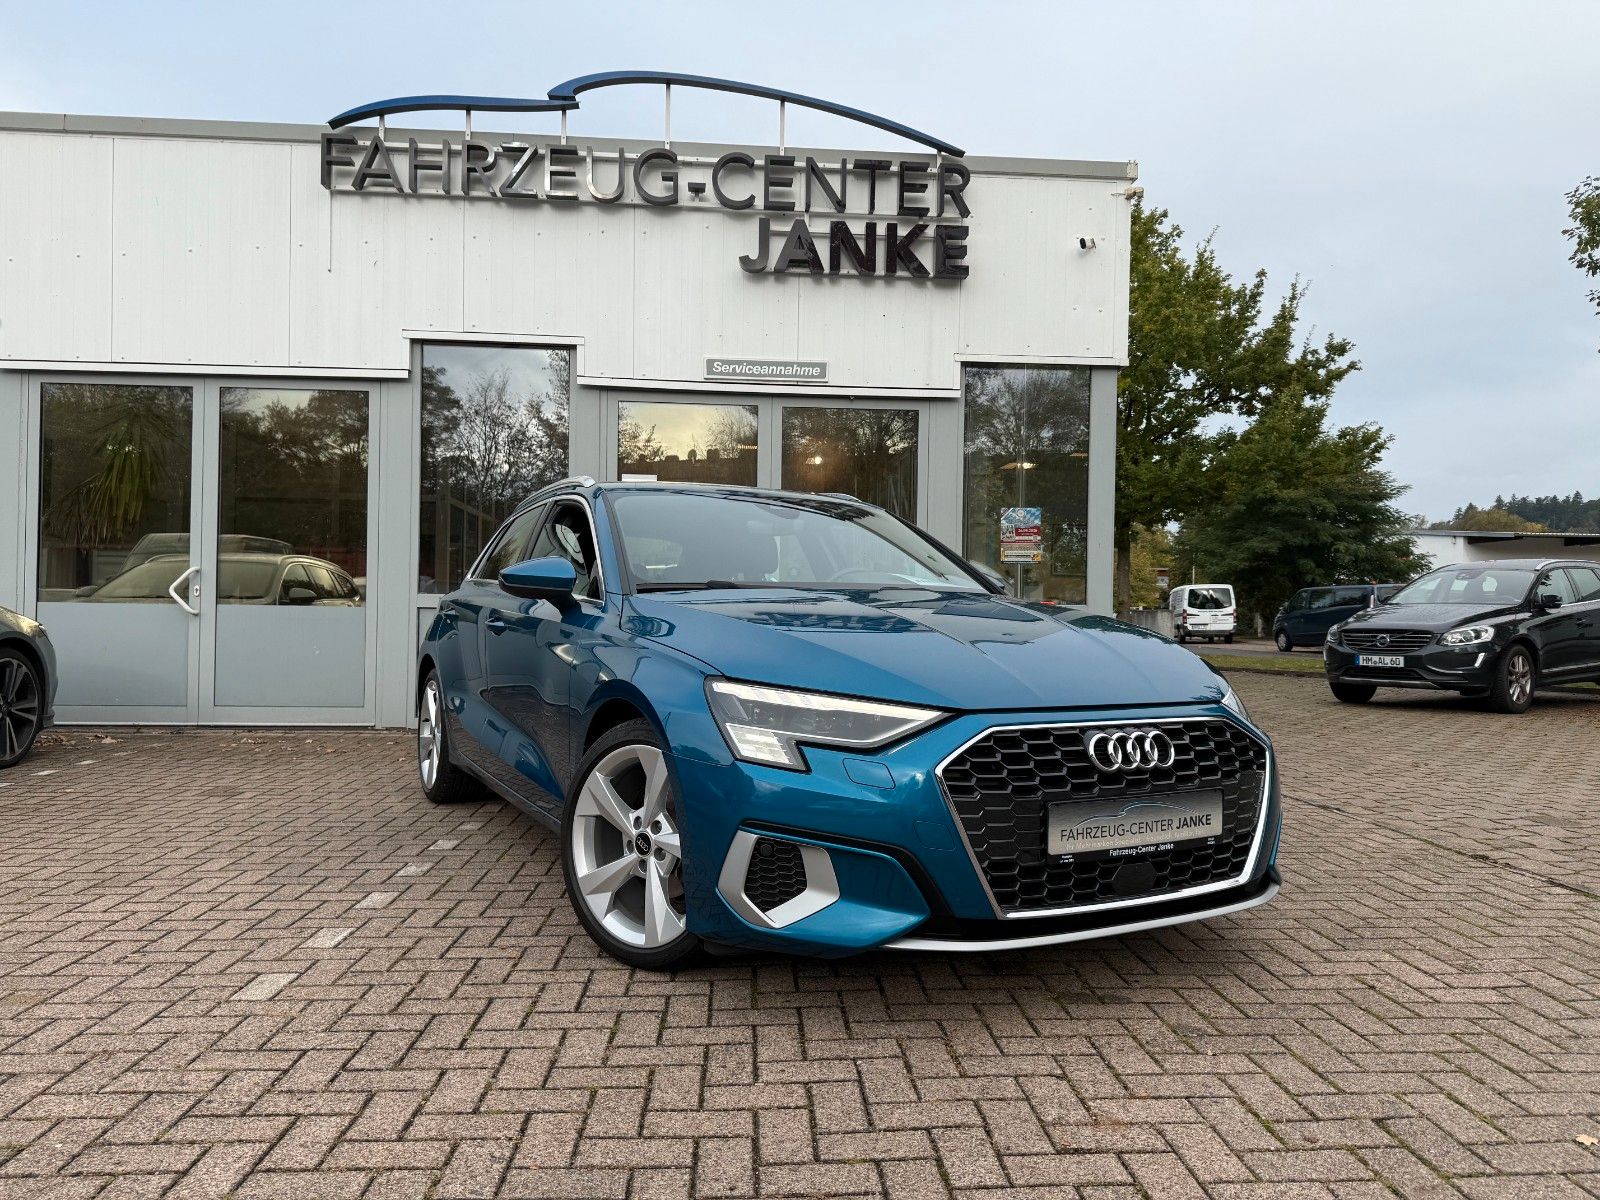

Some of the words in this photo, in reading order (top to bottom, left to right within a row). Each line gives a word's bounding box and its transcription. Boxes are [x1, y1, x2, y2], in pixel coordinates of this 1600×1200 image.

[320, 133, 971, 219] FAHRZEUG-CENTER
[738, 217, 970, 279] JANKE
[712, 361, 821, 376] Serviceannahme
[1390, 657, 1401, 666] 60
[1060, 818, 1174, 842] FAHRZEUG-CENTER
[1176, 813, 1212, 830] JANKE
[1109, 845, 1157, 857] Fahrzeug-Center
[1157, 843, 1174, 851] Janke
